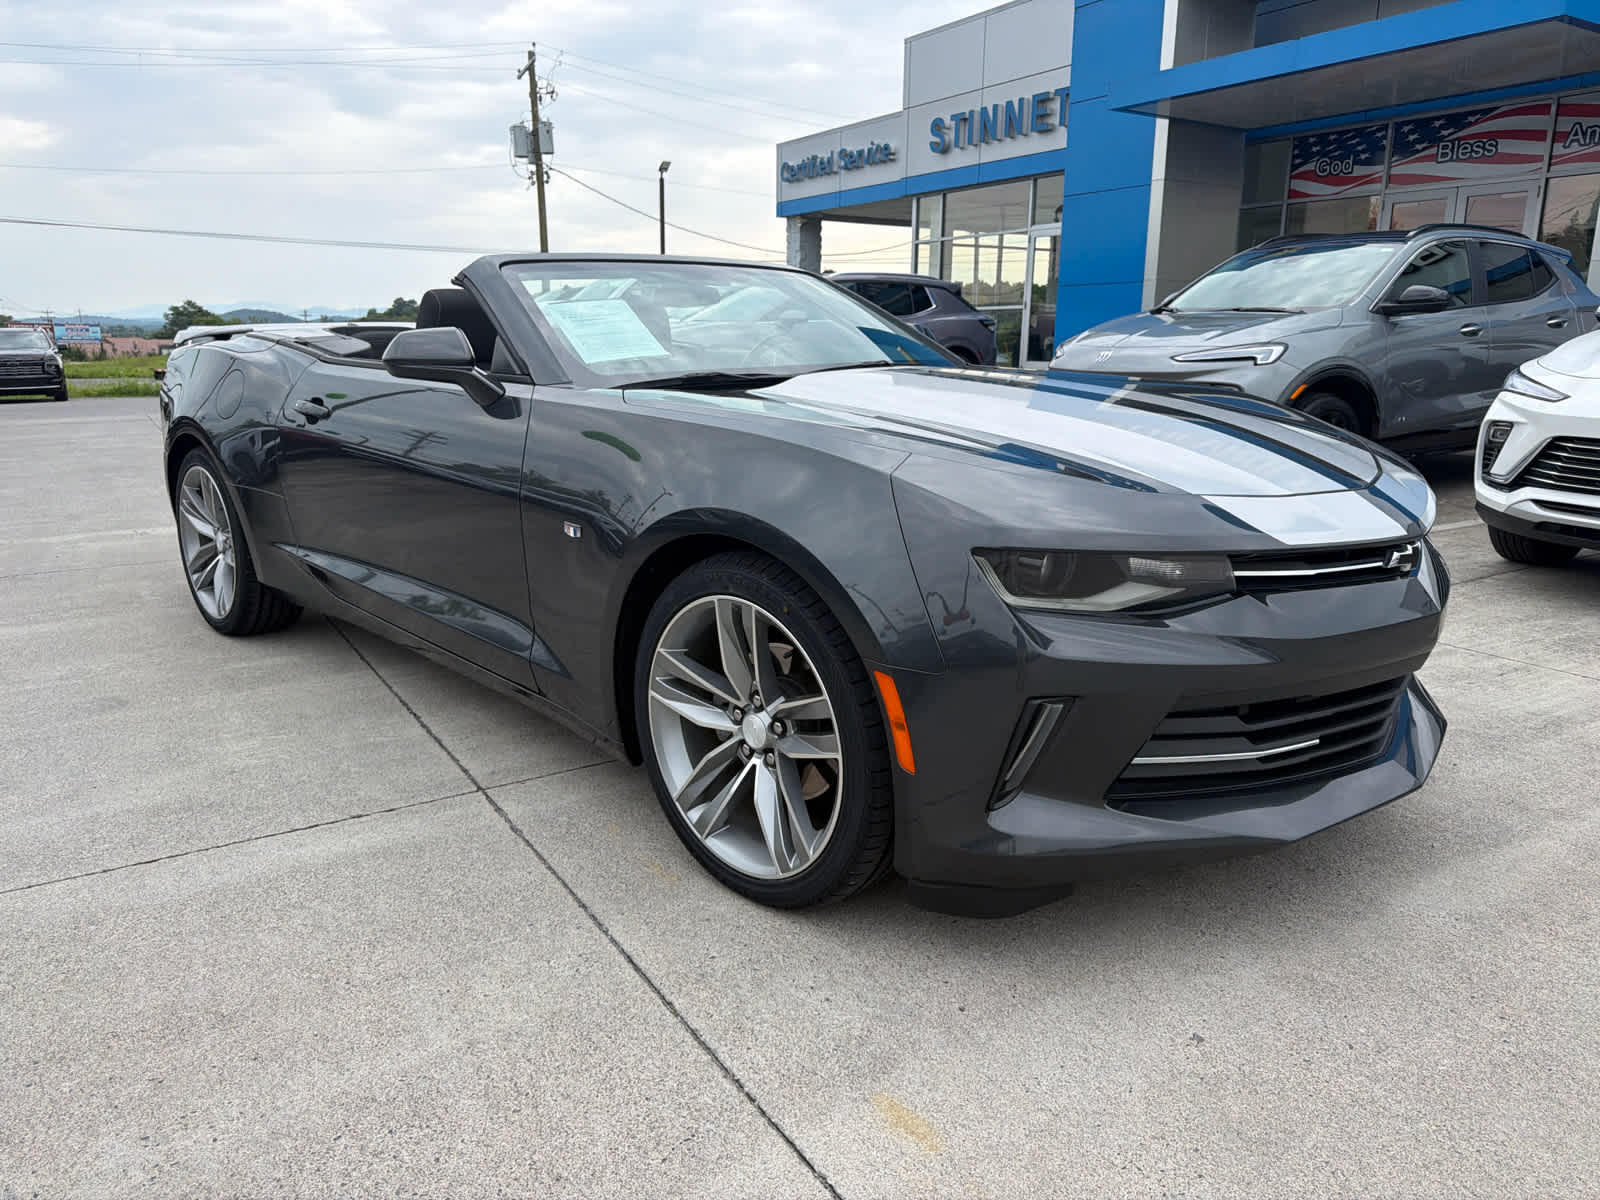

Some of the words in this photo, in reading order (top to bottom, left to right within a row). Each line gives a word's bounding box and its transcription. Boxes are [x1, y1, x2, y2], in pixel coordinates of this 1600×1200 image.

[929, 86, 1070, 153] STINNET
[780, 150, 836, 184] Certified
[838, 141, 894, 171] Service
[1315, 156, 1354, 177] God
[1437, 139, 1498, 163] Bless
